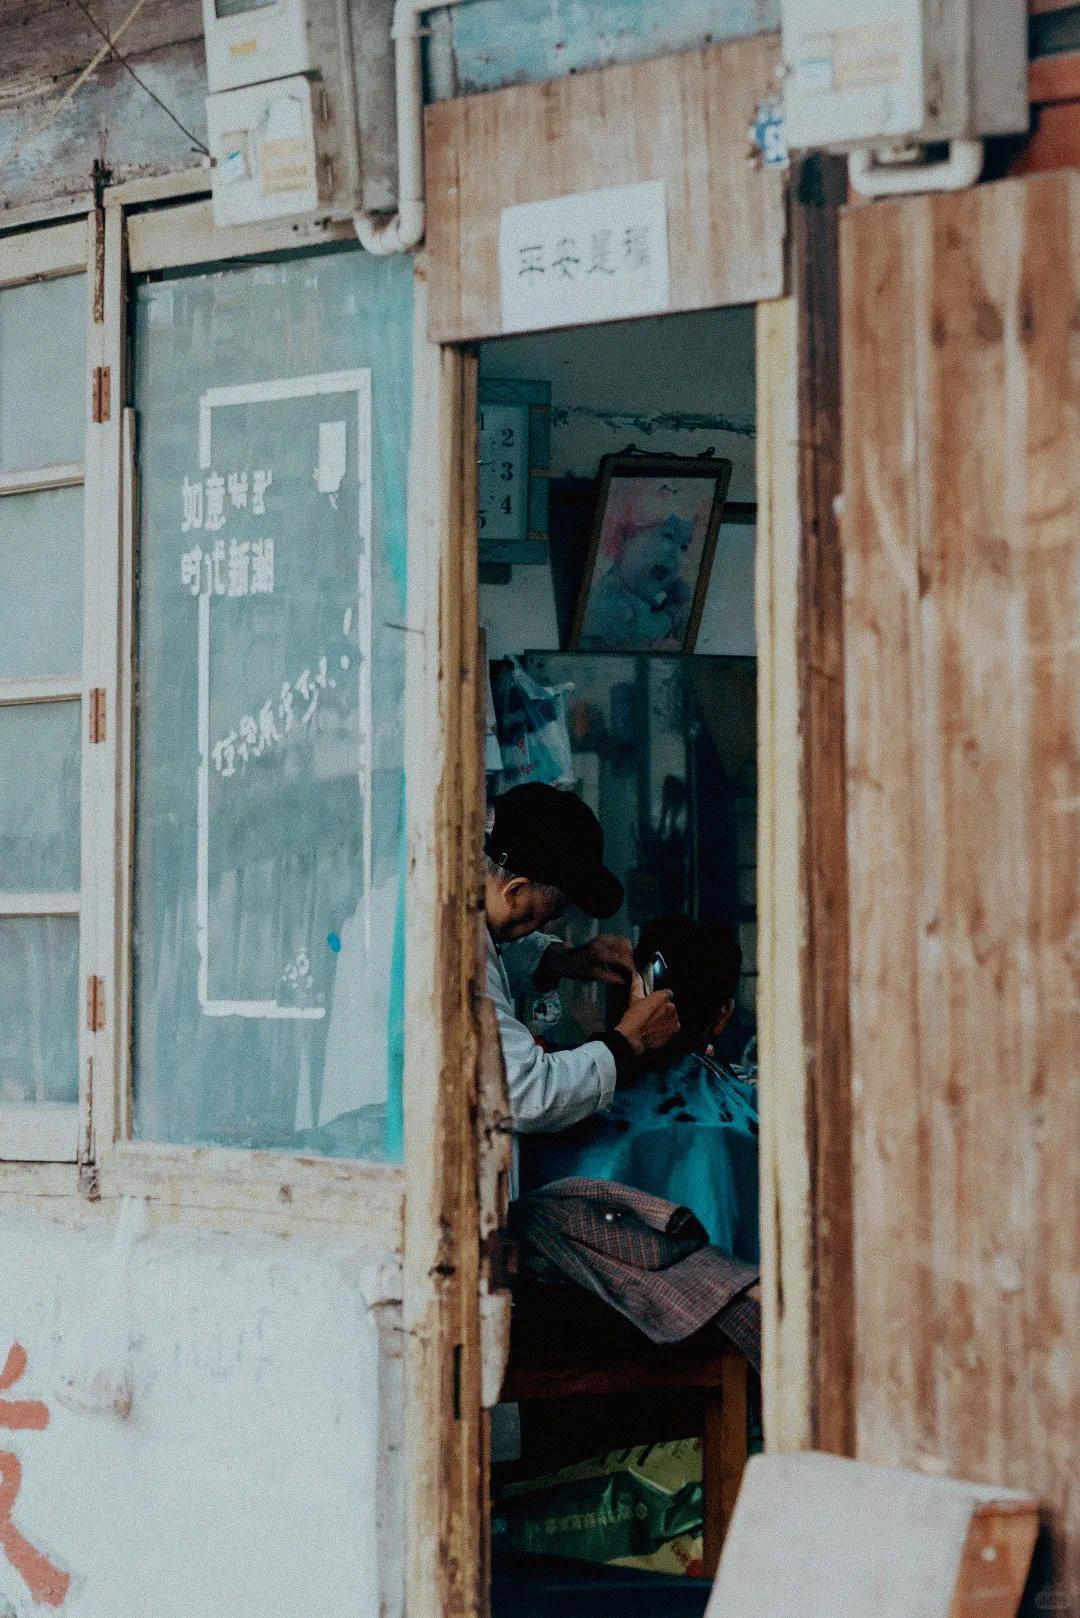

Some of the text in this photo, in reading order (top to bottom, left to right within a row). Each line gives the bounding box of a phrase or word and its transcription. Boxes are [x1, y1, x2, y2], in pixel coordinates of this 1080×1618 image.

[501, 427, 515, 448] 2
[501, 461, 514, 482] 3
[501, 495, 512, 515] 4
